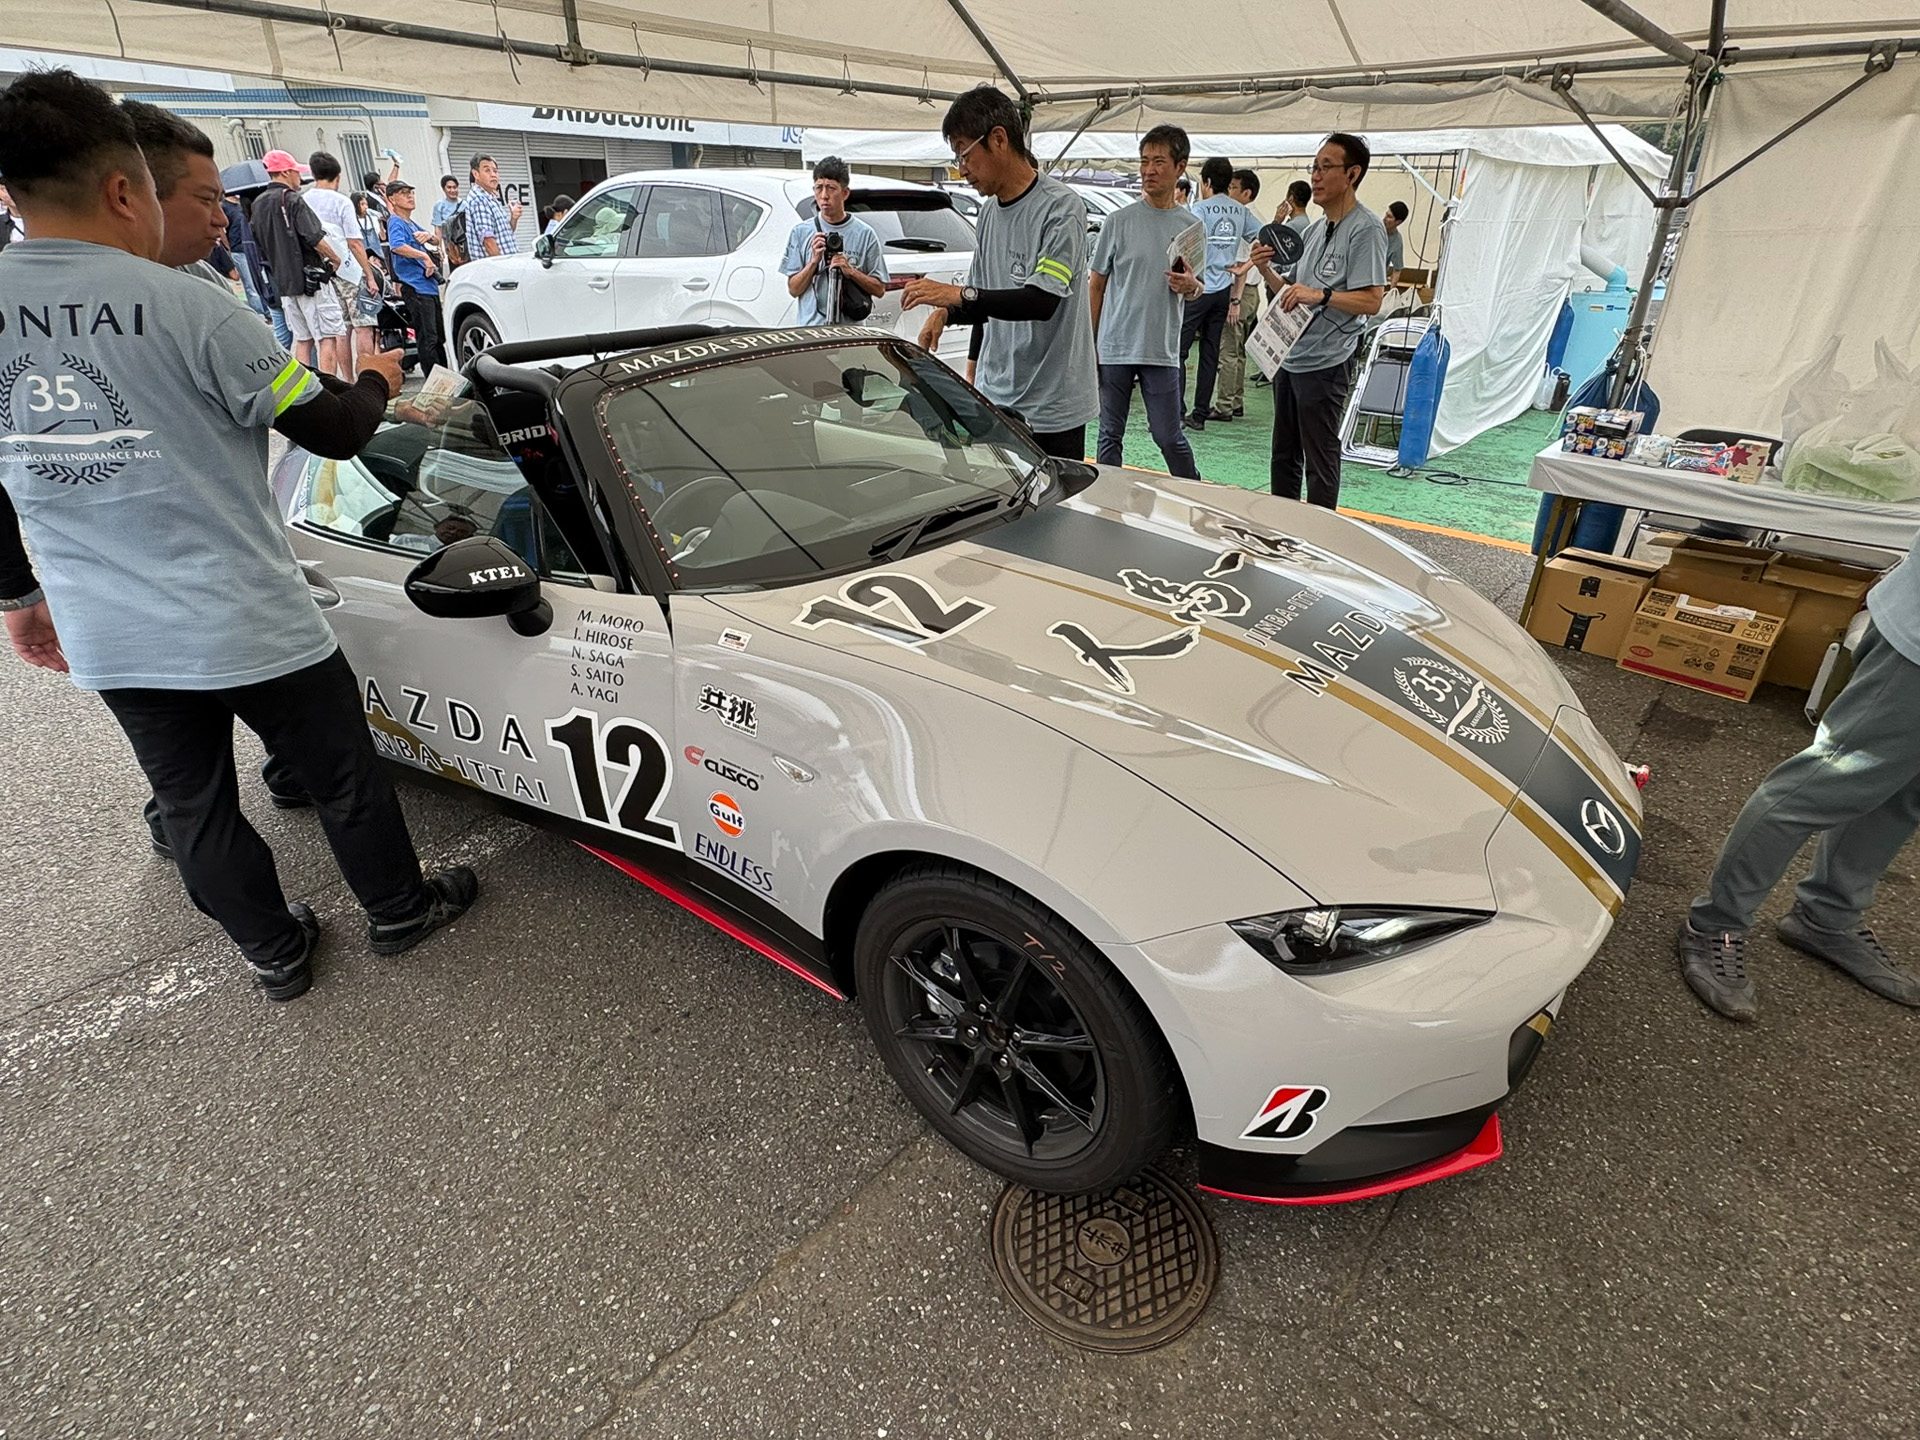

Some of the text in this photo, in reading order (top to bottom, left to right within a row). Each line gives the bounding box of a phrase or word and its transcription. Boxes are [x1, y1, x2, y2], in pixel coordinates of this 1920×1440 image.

[497, 184, 529, 206] ACE
[0, 303, 143, 338] NTAI
[619, 326, 883, 374] MAZDA SPIRIT RACING
[498, 425, 551, 445] BRID
[66, 451, 131, 462] ENDURANCE
[134, 449, 162, 459] RACE
[469, 565, 526, 585] KTEL
[577, 609, 644, 633] M. MORO
[794, 573, 994, 650] 12
[573, 627, 634, 651] I. HIROSE
[1282, 600, 1404, 697] MAZDA
[571, 645, 625, 669] N. SAGA
[570, 663, 625, 687] S. SAITO
[570, 682, 618, 703] A. YAGI
[363, 677, 537, 763] AZDA
[371, 728, 550, 805] NBA-ITTAI
[546, 708, 683, 850] 12
[709, 802, 743, 828] Gulf
[695, 833, 773, 892] ENDLESS
